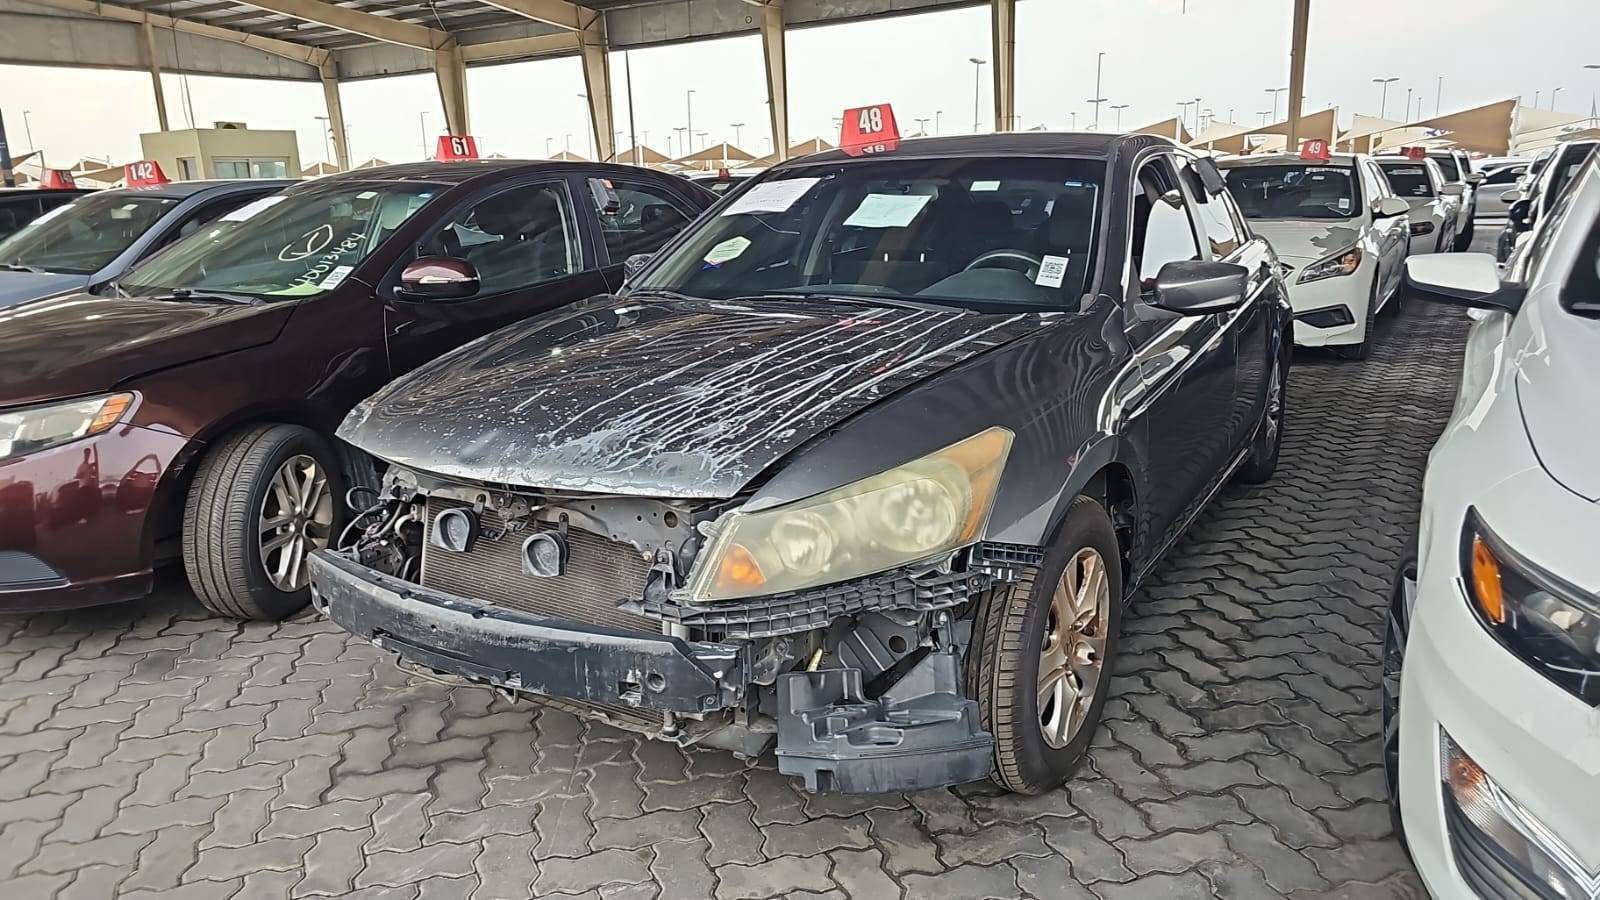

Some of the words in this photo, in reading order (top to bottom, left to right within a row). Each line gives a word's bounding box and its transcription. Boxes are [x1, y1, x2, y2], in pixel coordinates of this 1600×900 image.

[859, 107, 883, 134] 48
[451, 136, 470, 156] 61
[1308, 141, 1321, 154] 49
[130, 162, 154, 180] 142
